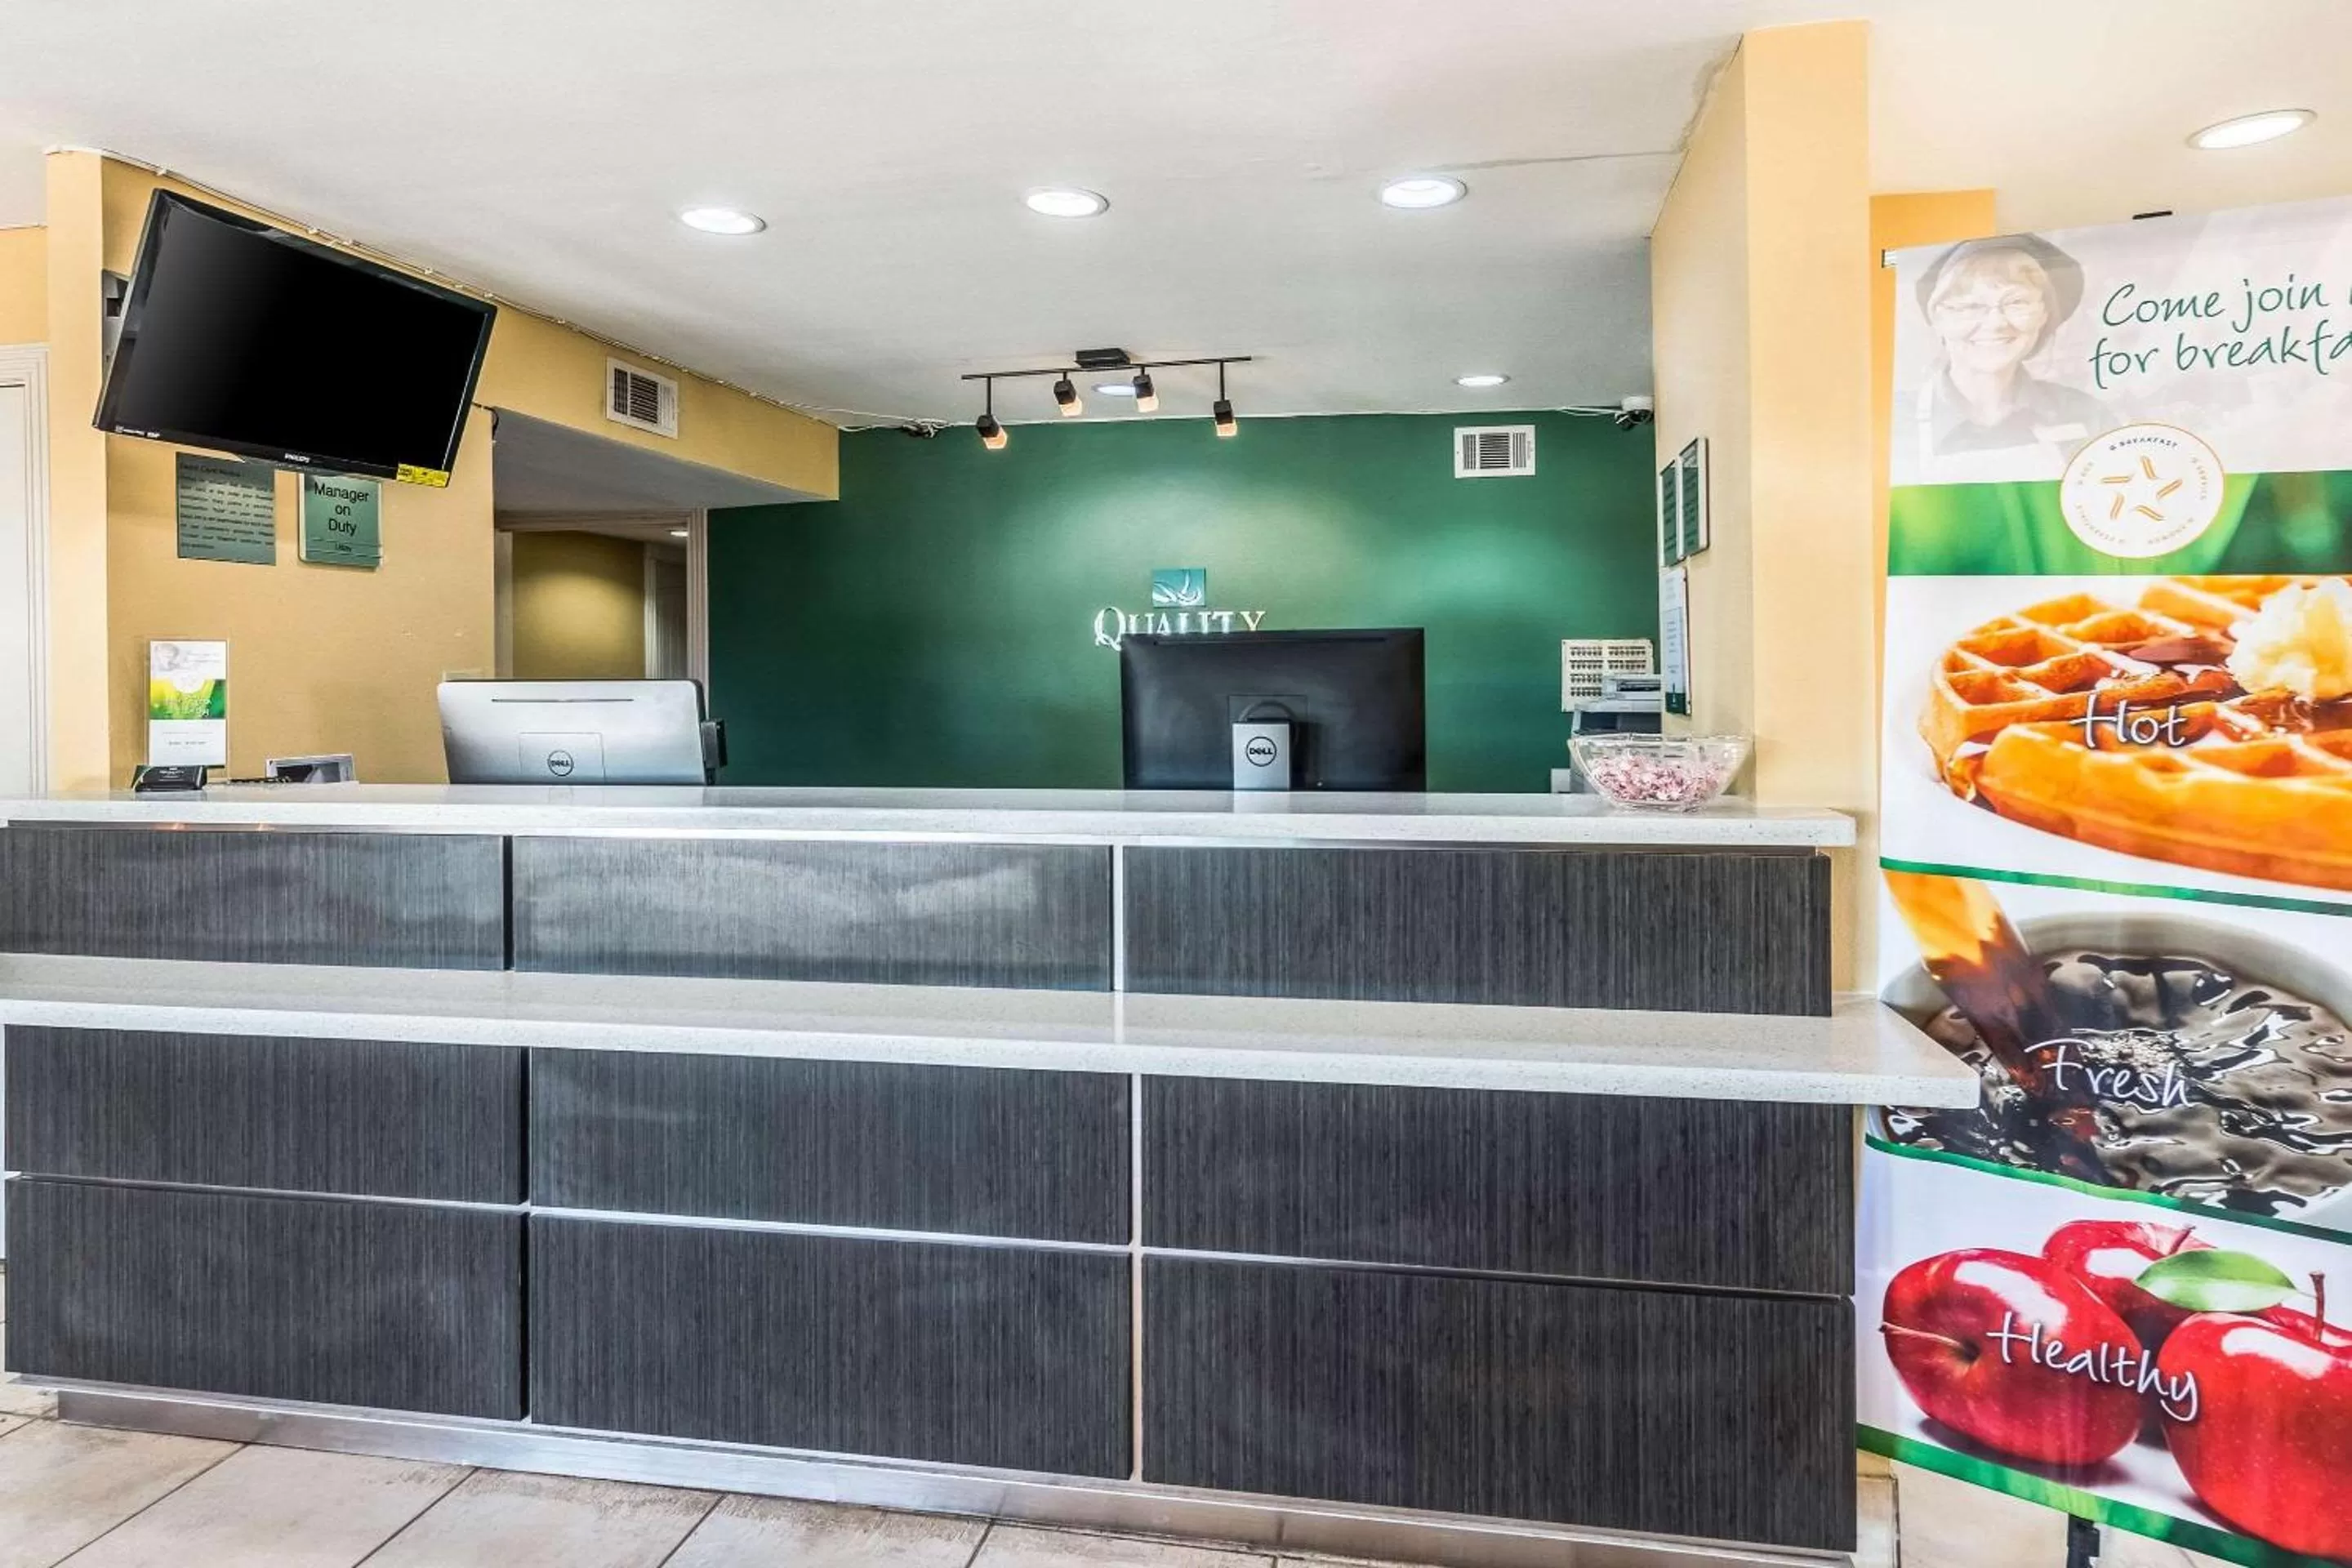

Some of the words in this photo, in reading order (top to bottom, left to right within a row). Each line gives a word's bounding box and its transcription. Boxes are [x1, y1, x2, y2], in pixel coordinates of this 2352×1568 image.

[2103, 283, 2225, 327] Come
[2232, 274, 2330, 332] join
[2088, 336, 2159, 390] for
[2176, 318, 2352, 376] breakfa
[314, 482, 370, 504] Manager
[335, 504, 351, 516] on
[328, 518, 357, 537] Duty
[1094, 606, 1267, 651] QUALITY
[2069, 693, 2188, 750] Hot
[1249, 747, 1274, 755] DELL
[2024, 1038, 2196, 1107] Fresh
[1986, 1311, 2200, 1422] Healthy
